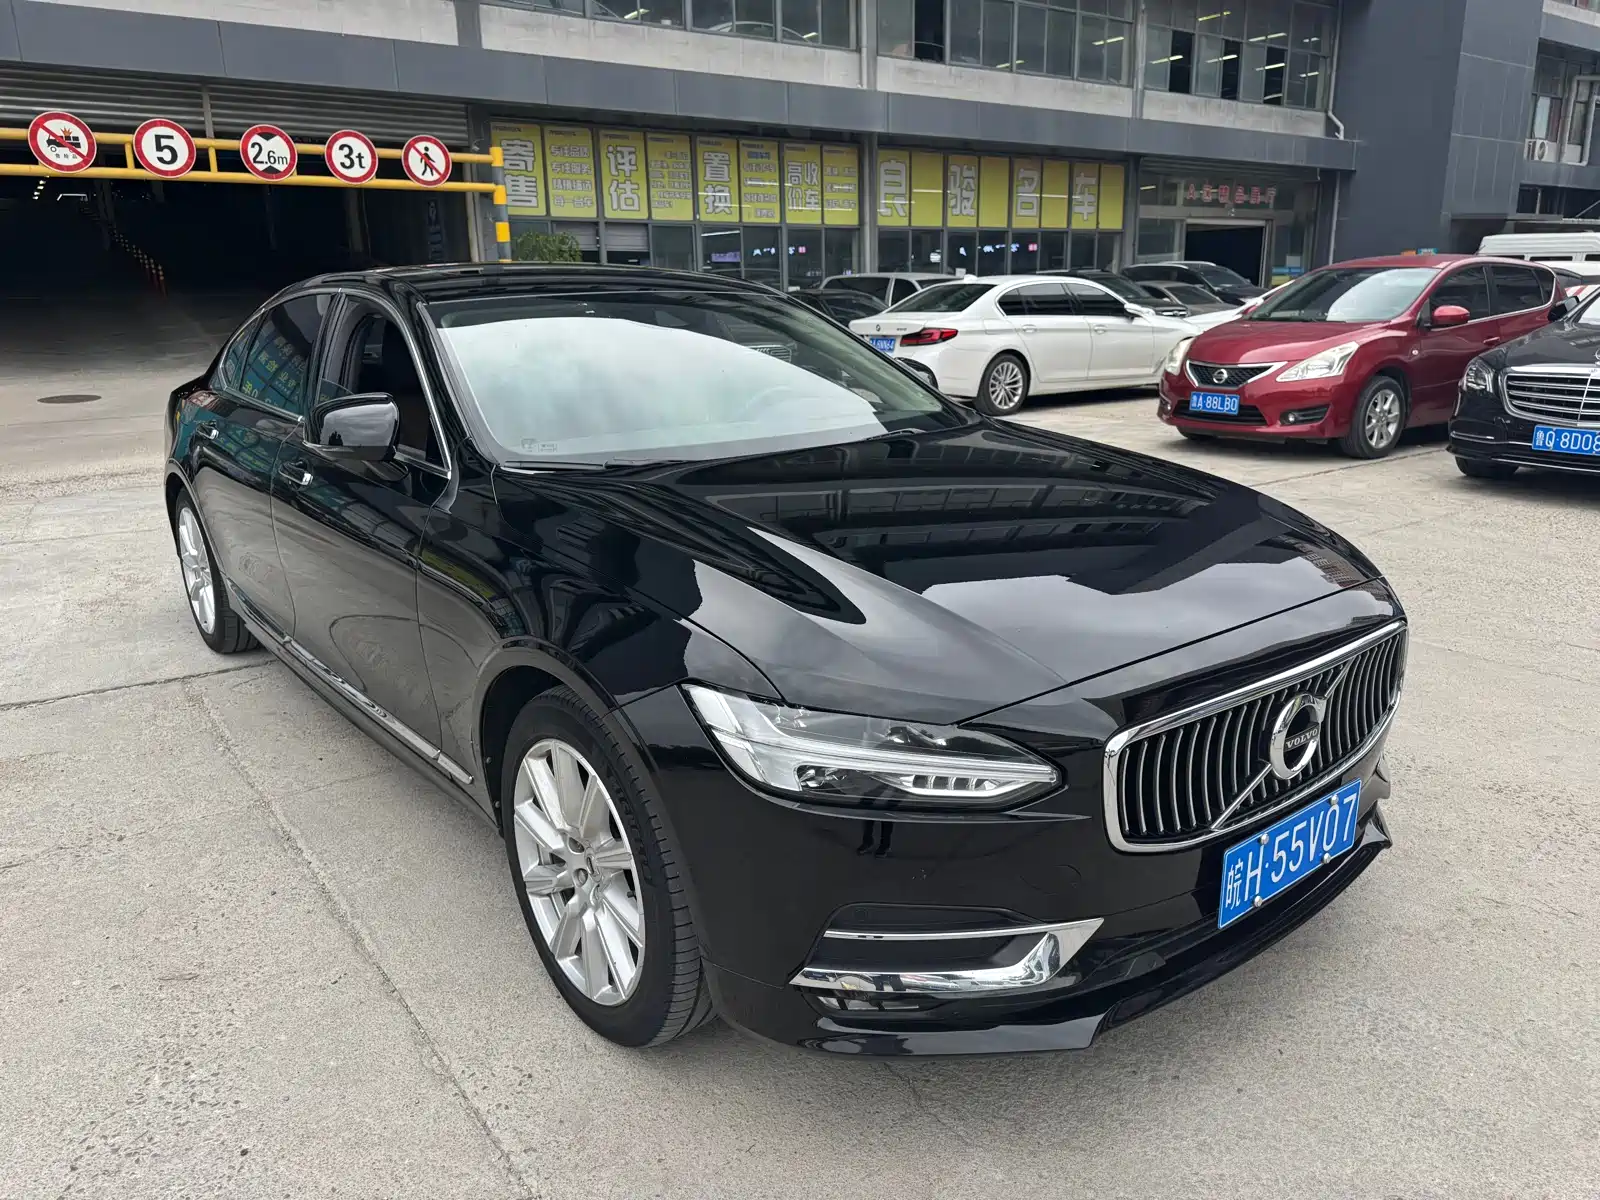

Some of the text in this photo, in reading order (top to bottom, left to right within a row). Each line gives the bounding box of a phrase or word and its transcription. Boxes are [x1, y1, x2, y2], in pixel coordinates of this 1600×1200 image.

[154, 134, 179, 165] 5
[250, 141, 288, 166] 2.6m
[338, 143, 366, 169] 3t
[606, 145, 640, 211] 评估
[702, 151, 732, 215] 置换
[1285, 728, 1318, 749] VOLVO
